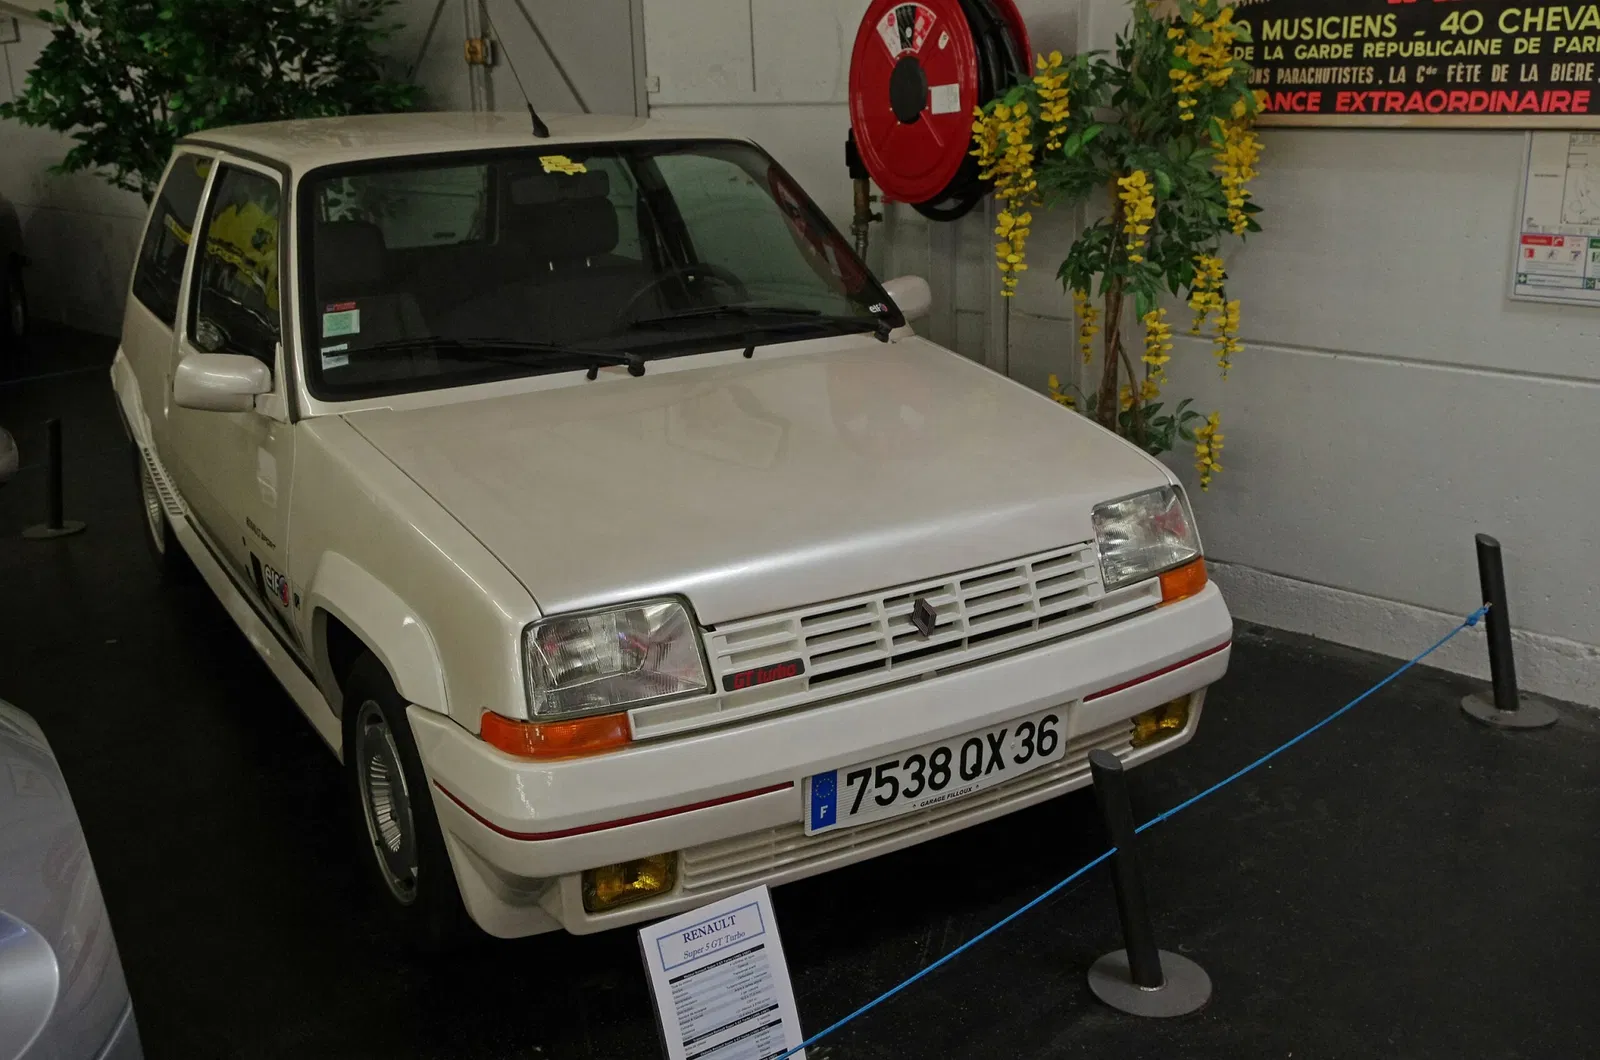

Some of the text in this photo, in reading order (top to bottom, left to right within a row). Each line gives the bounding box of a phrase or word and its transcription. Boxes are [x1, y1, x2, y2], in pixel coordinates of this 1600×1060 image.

[1262, 13, 1398, 41] MUSICIENS
[1440, 9, 1484, 35] 40
[1498, 5, 1600, 34] CHEVA
[1233, 46, 1254, 61] DE
[1264, 45, 1284, 61] LA
[1294, 43, 1354, 60] GARDE
[1513, 37, 1541, 55] DE
[1553, 35, 1600, 54] PARI
[1248, 67, 1271, 84] ONS
[1389, 66, 1406, 83] LA
[1491, 64, 1509, 82] DE
[1520, 63, 1539, 82] LA
[1335, 89, 1590, 113] EXTRAORDINAIRE
[733, 663, 798, 690] GT turbo
[846, 714, 1059, 815] 7538 QX 36
[920, 786, 972, 807] GARAGE FILLOUX
[819, 805, 828, 819] F
[682, 914, 736, 943] RENAULT
[683, 931, 746, 960] Super 5 GT Turbo
